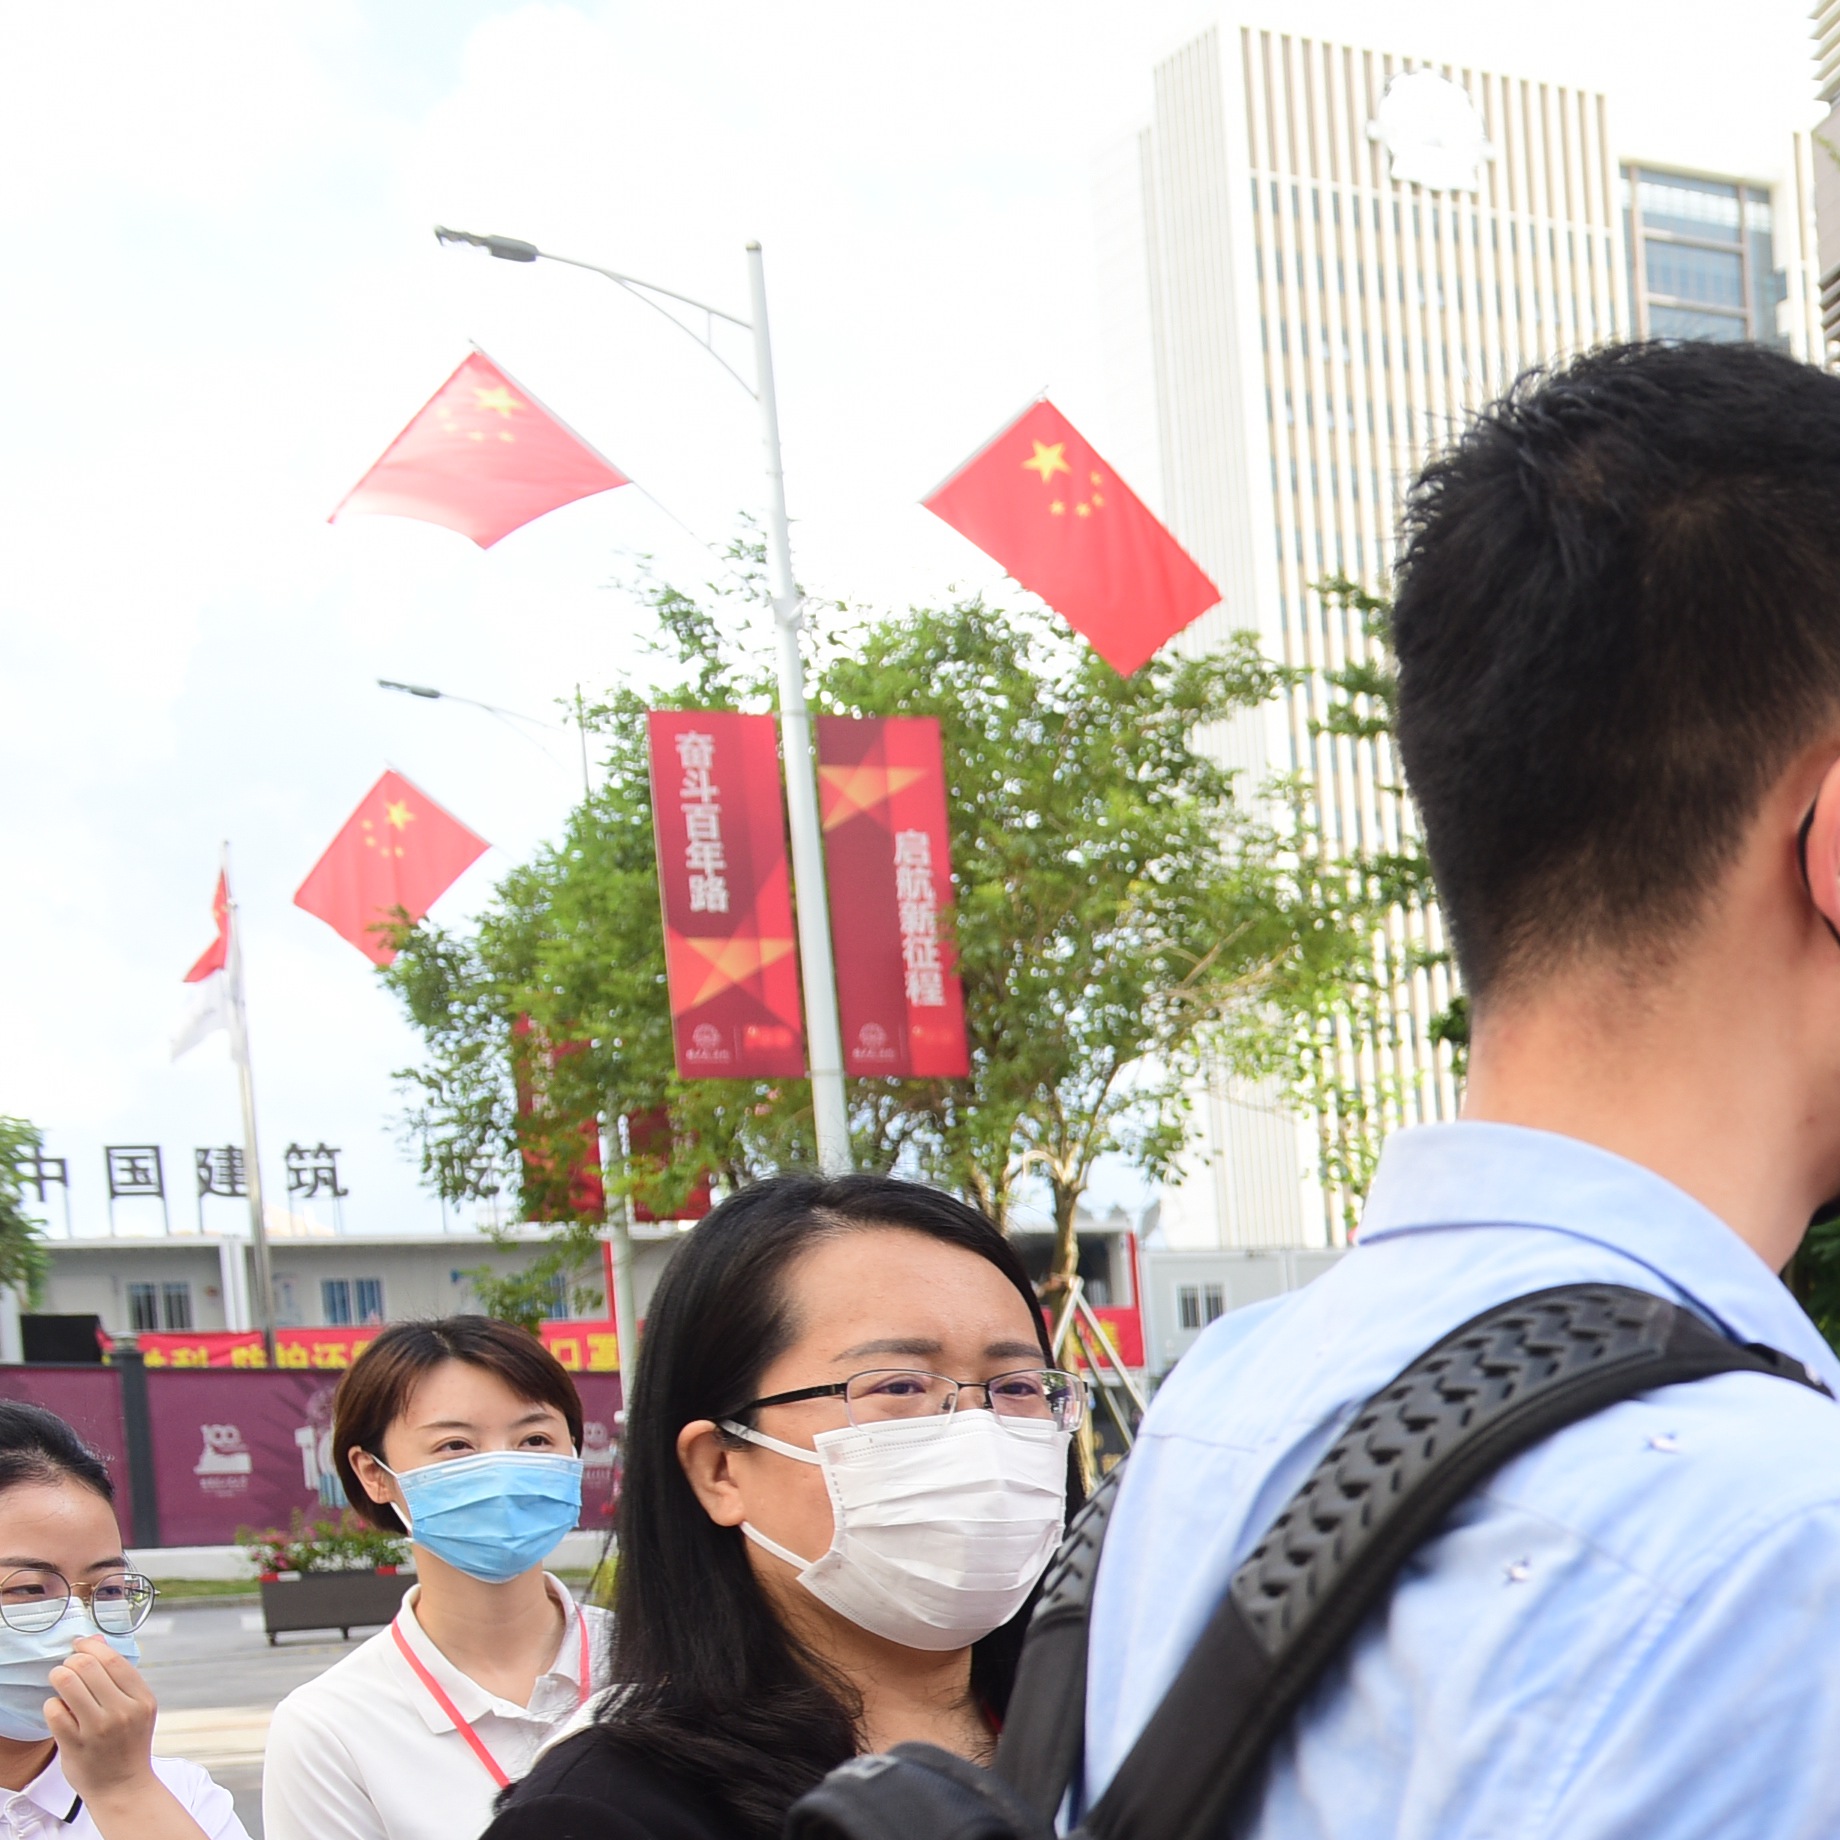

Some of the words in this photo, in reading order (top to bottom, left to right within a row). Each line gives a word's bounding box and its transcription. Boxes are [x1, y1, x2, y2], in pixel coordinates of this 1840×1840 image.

[675, 730, 730, 913] 奋斗百年路
[894, 828, 946, 1007] 启航新征程
